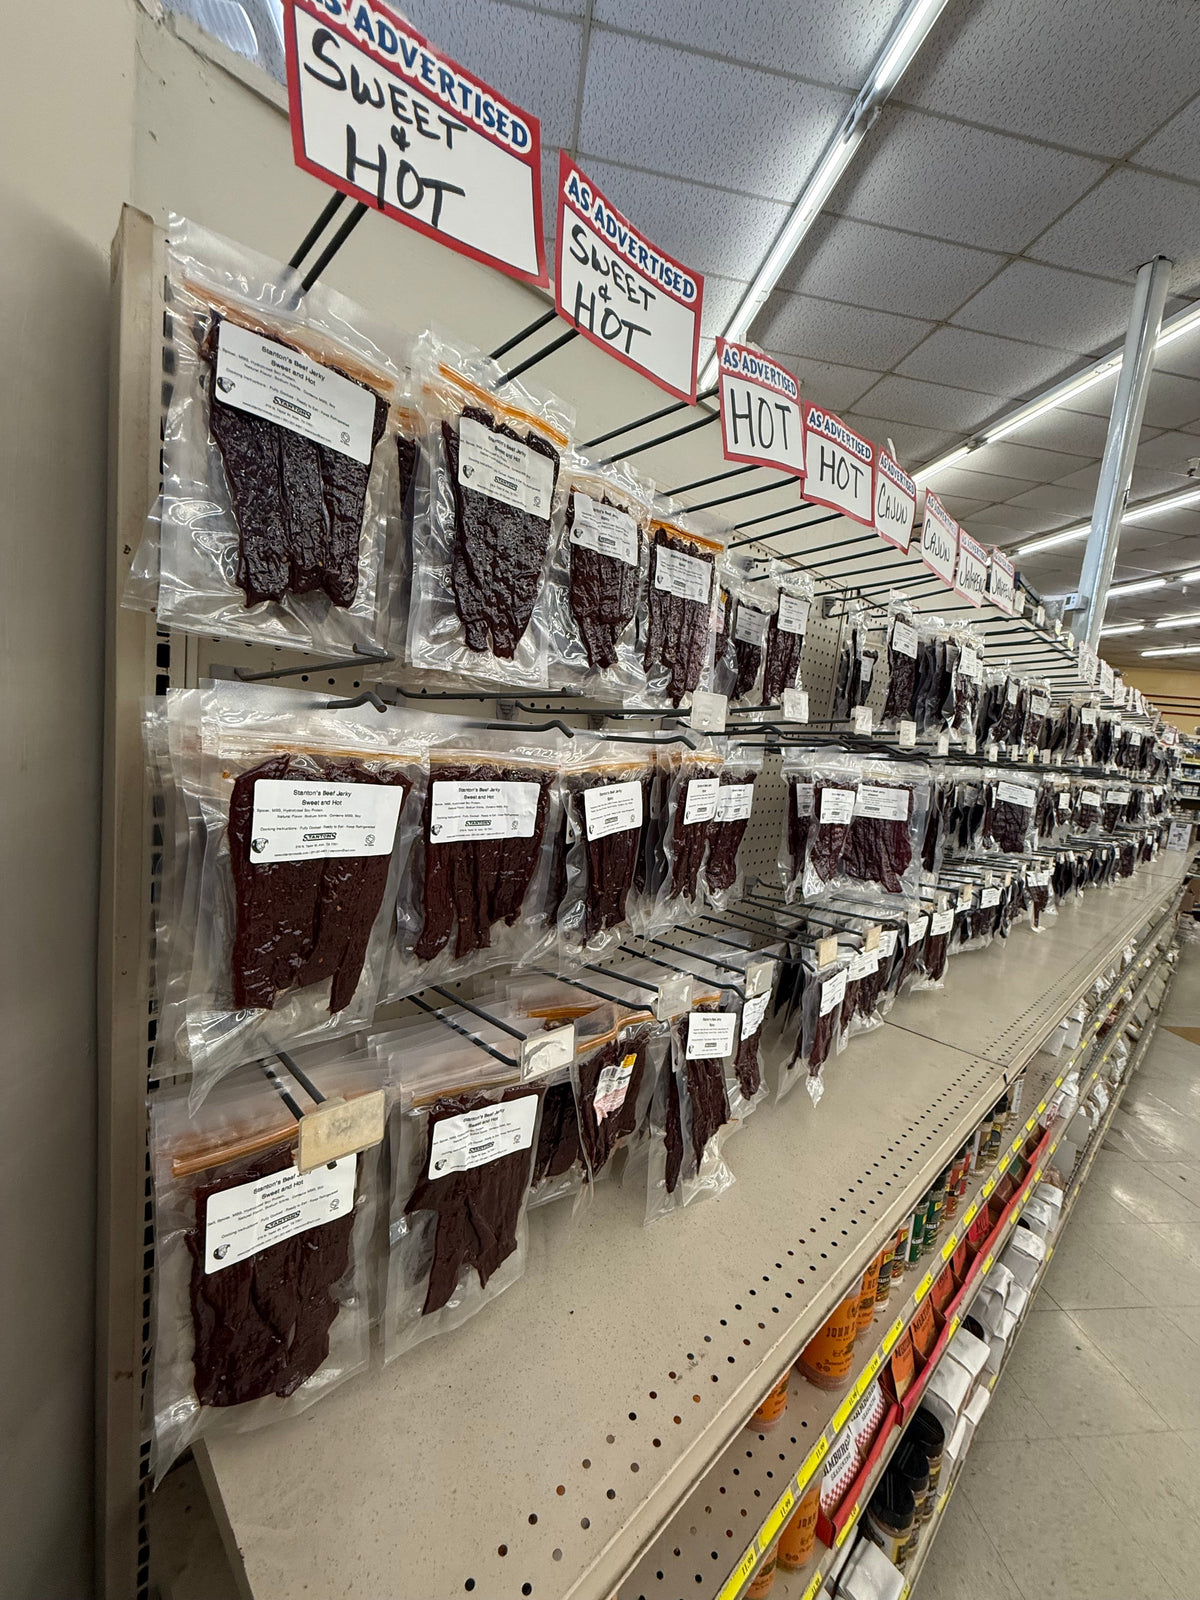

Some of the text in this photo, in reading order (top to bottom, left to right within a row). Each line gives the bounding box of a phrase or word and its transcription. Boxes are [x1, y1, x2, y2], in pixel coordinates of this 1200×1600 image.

[303, 27, 468, 150] SWEET
[353, 5, 529, 149] ADVERTISED
[390, 124, 411, 152] &
[345, 123, 466, 229] HOT
[568, 176, 695, 299] AS ADVERTISED
[569, 223, 656, 311] SWEET
[574, 280, 652, 354] HOT
[309, 367, 326, 382] Jerky
[723, 348, 797, 397] AS ADVERTISED
[730, 387, 792, 450] HOT
[809, 410, 871, 460] AS ADVERTISED
[819, 445, 865, 498] HOT
[880, 456, 915, 495] AS ADVERTISED
[877, 482, 908, 525] CAJUN
[923, 518, 951, 562] CAJUN
[815, 1441, 826, 1459] 11.99
[780, 1498, 791, 1518] 11.99
[741, 1555, 754, 1576] 11.99
